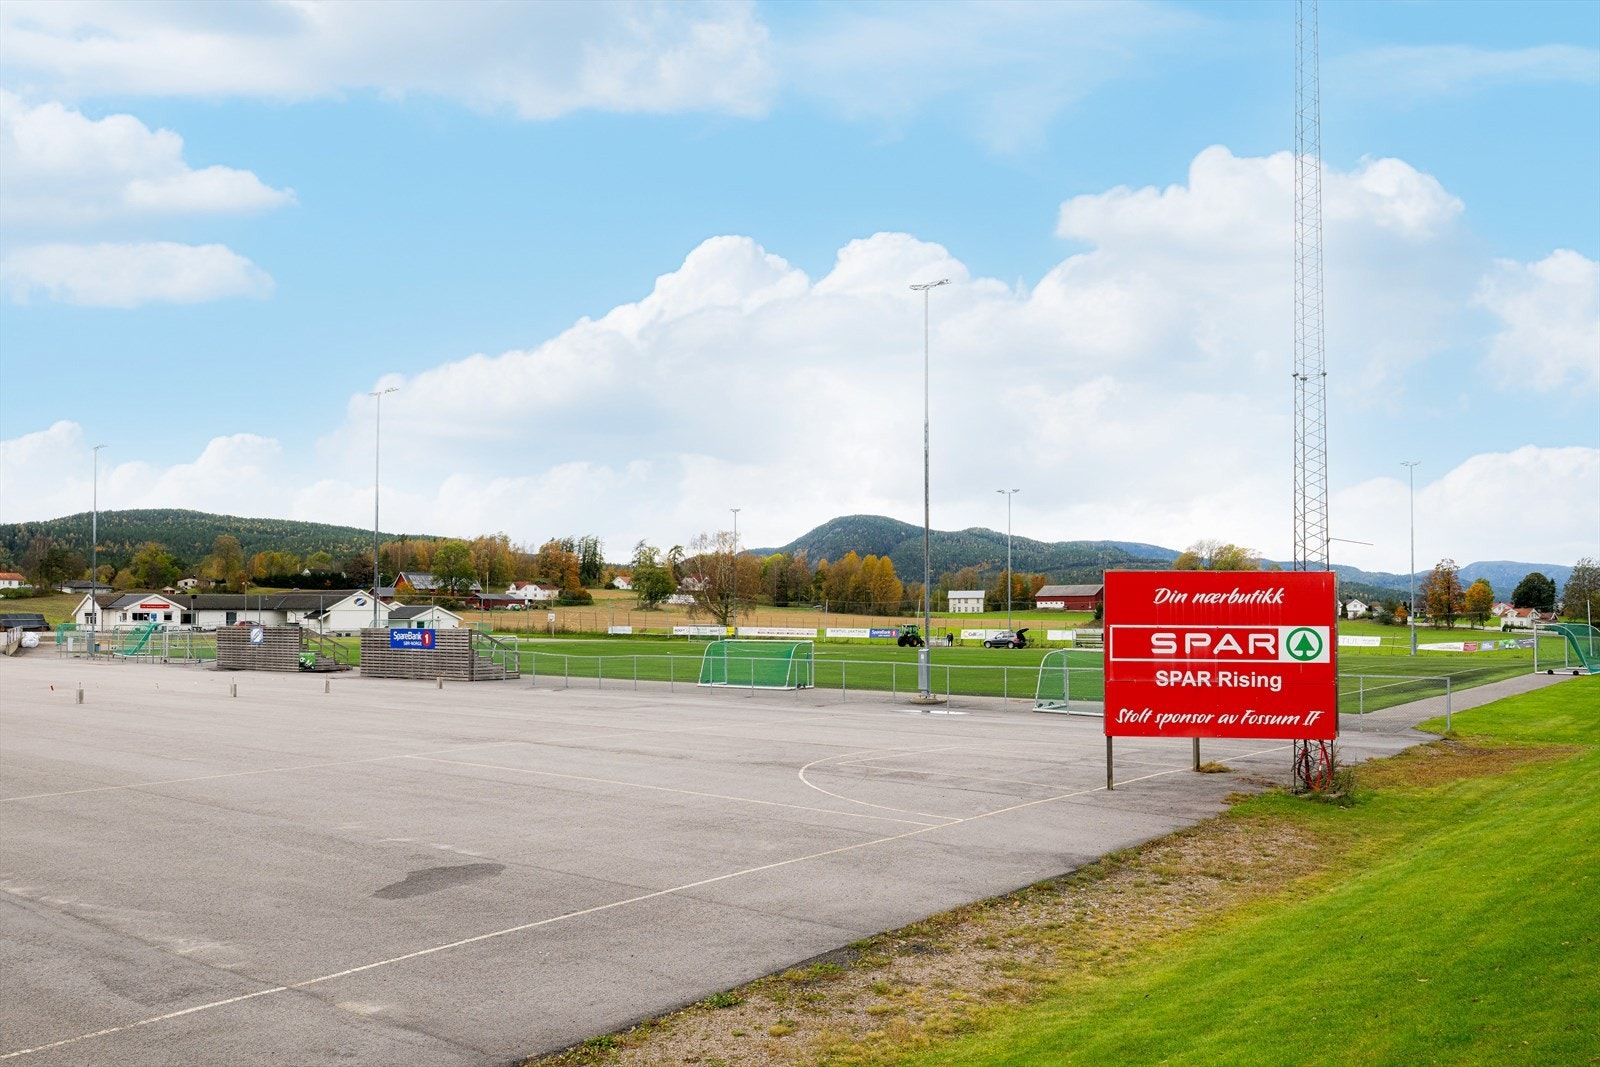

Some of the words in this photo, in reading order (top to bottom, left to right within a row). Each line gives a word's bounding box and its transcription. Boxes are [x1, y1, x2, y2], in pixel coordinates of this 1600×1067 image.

[1153, 587, 1187, 604] Din
[1192, 587, 1285, 604] nærbutikk
[393, 631, 422, 641] SpareBank
[1150, 632, 1277, 655] SPAR
[1155, 670, 1211, 688] SPAR
[1218, 670, 1282, 692] Rising
[1115, 708, 1153, 724] Stolt
[1154, 712, 1214, 729] sponsor
[1217, 713, 1239, 725] av
[1240, 709, 1300, 726] Fossum
[1302, 710, 1324, 727] IF
